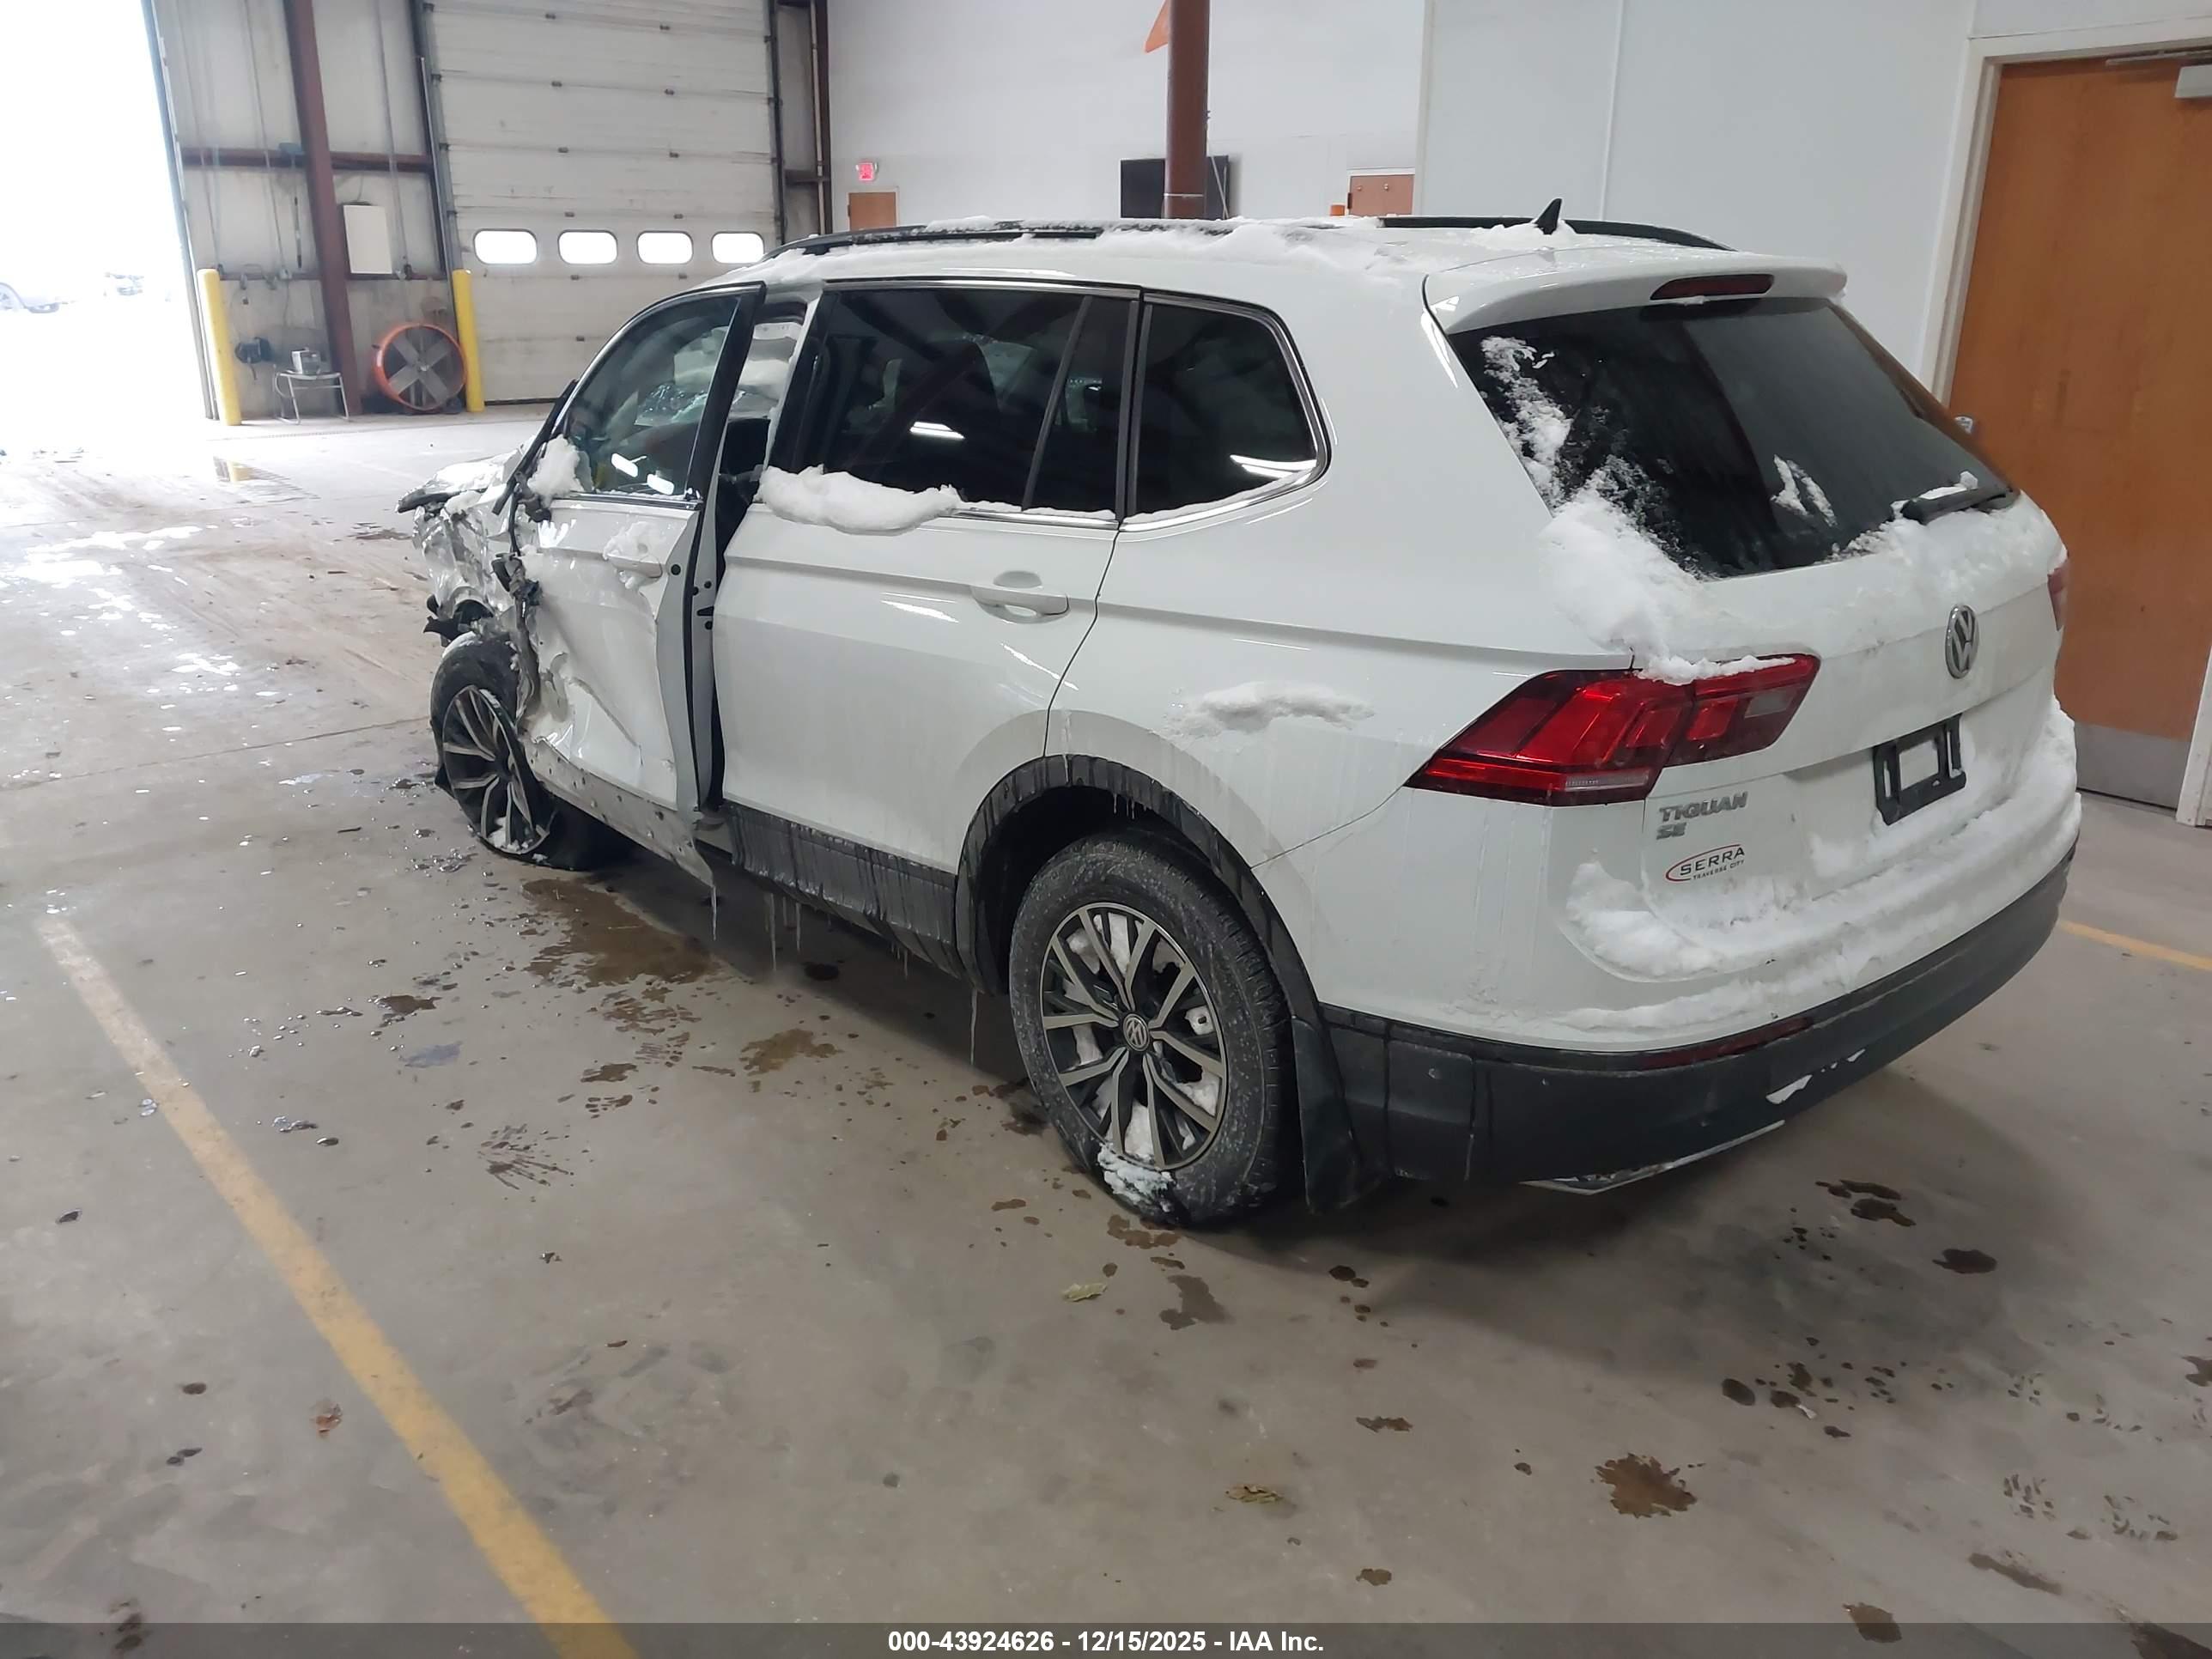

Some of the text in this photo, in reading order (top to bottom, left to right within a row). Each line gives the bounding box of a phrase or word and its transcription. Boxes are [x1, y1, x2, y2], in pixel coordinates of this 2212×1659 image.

[1656, 822, 1687, 841] SE
[1680, 847, 1746, 876] SERRA
[1729, 860, 1745, 870] CITY
